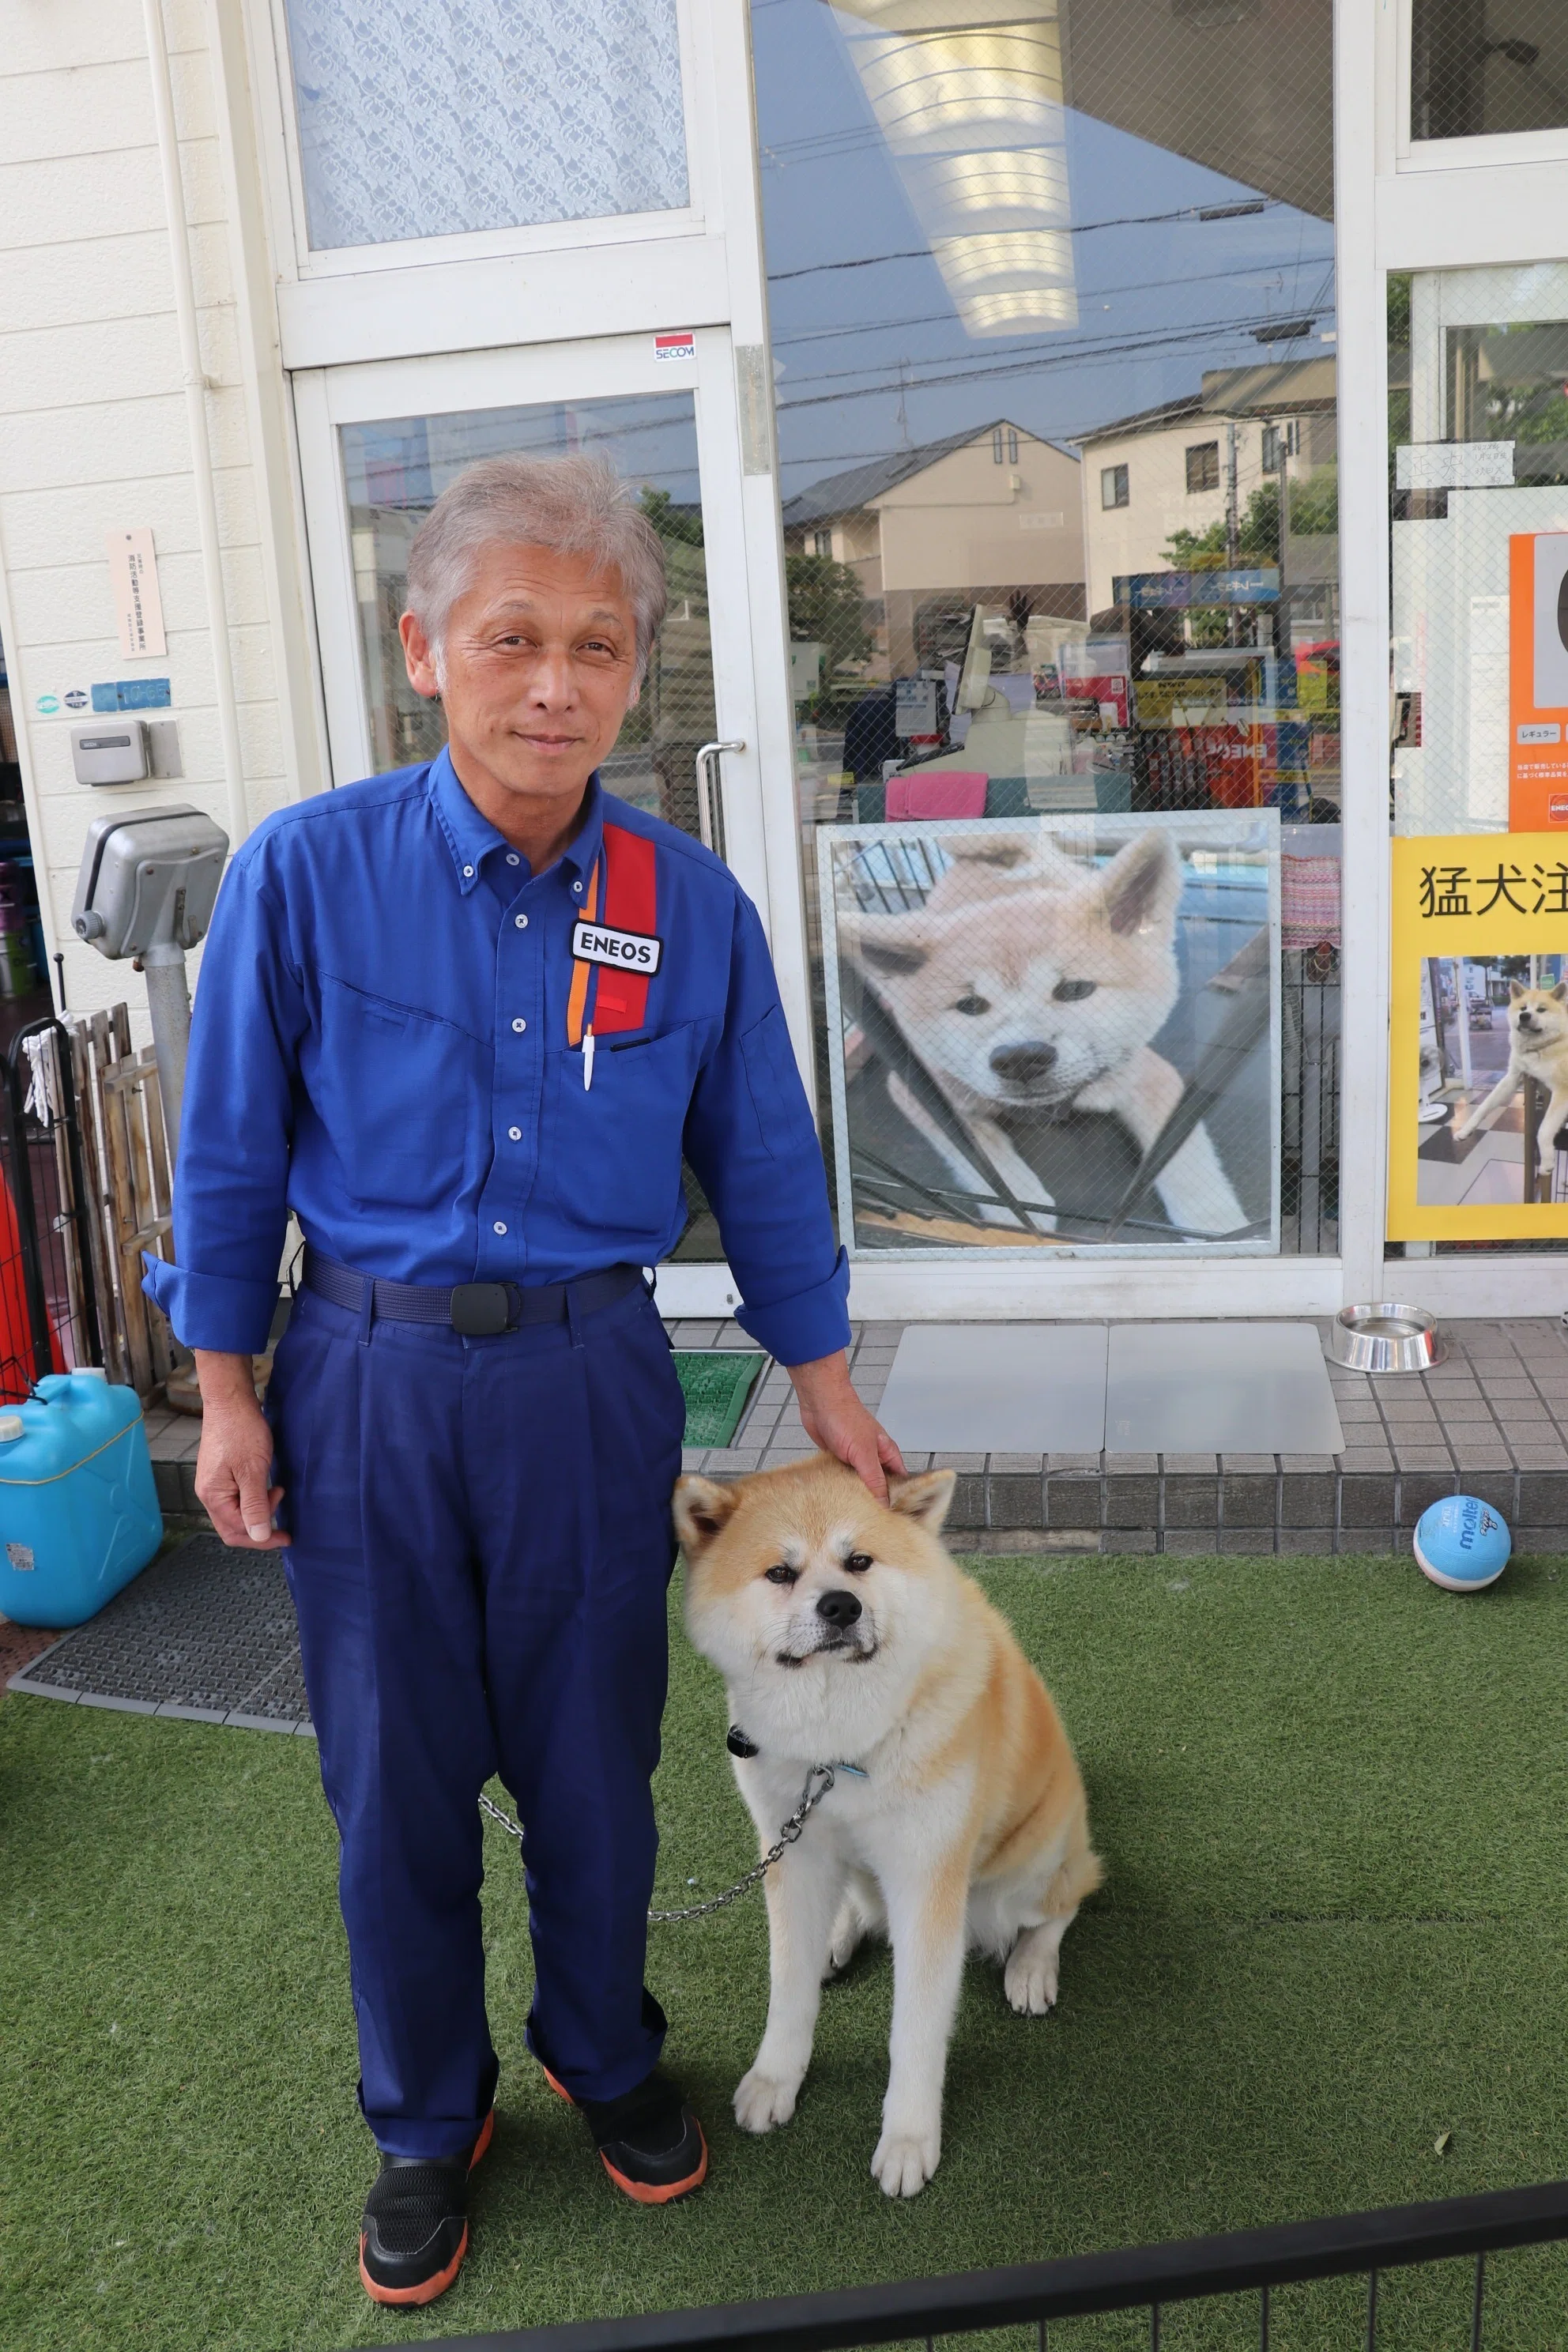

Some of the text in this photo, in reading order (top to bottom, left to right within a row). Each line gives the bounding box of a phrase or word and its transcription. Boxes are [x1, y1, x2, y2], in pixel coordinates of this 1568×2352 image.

[656, 346, 695, 359] SECOM
[128, 554, 146, 650] 消防活動等支援登録事業所
[1517, 762, 1568, 771] 当店で販売している
[1419, 862, 1568, 918] 猛犬注
[581, 932, 650, 963] ENEOS
